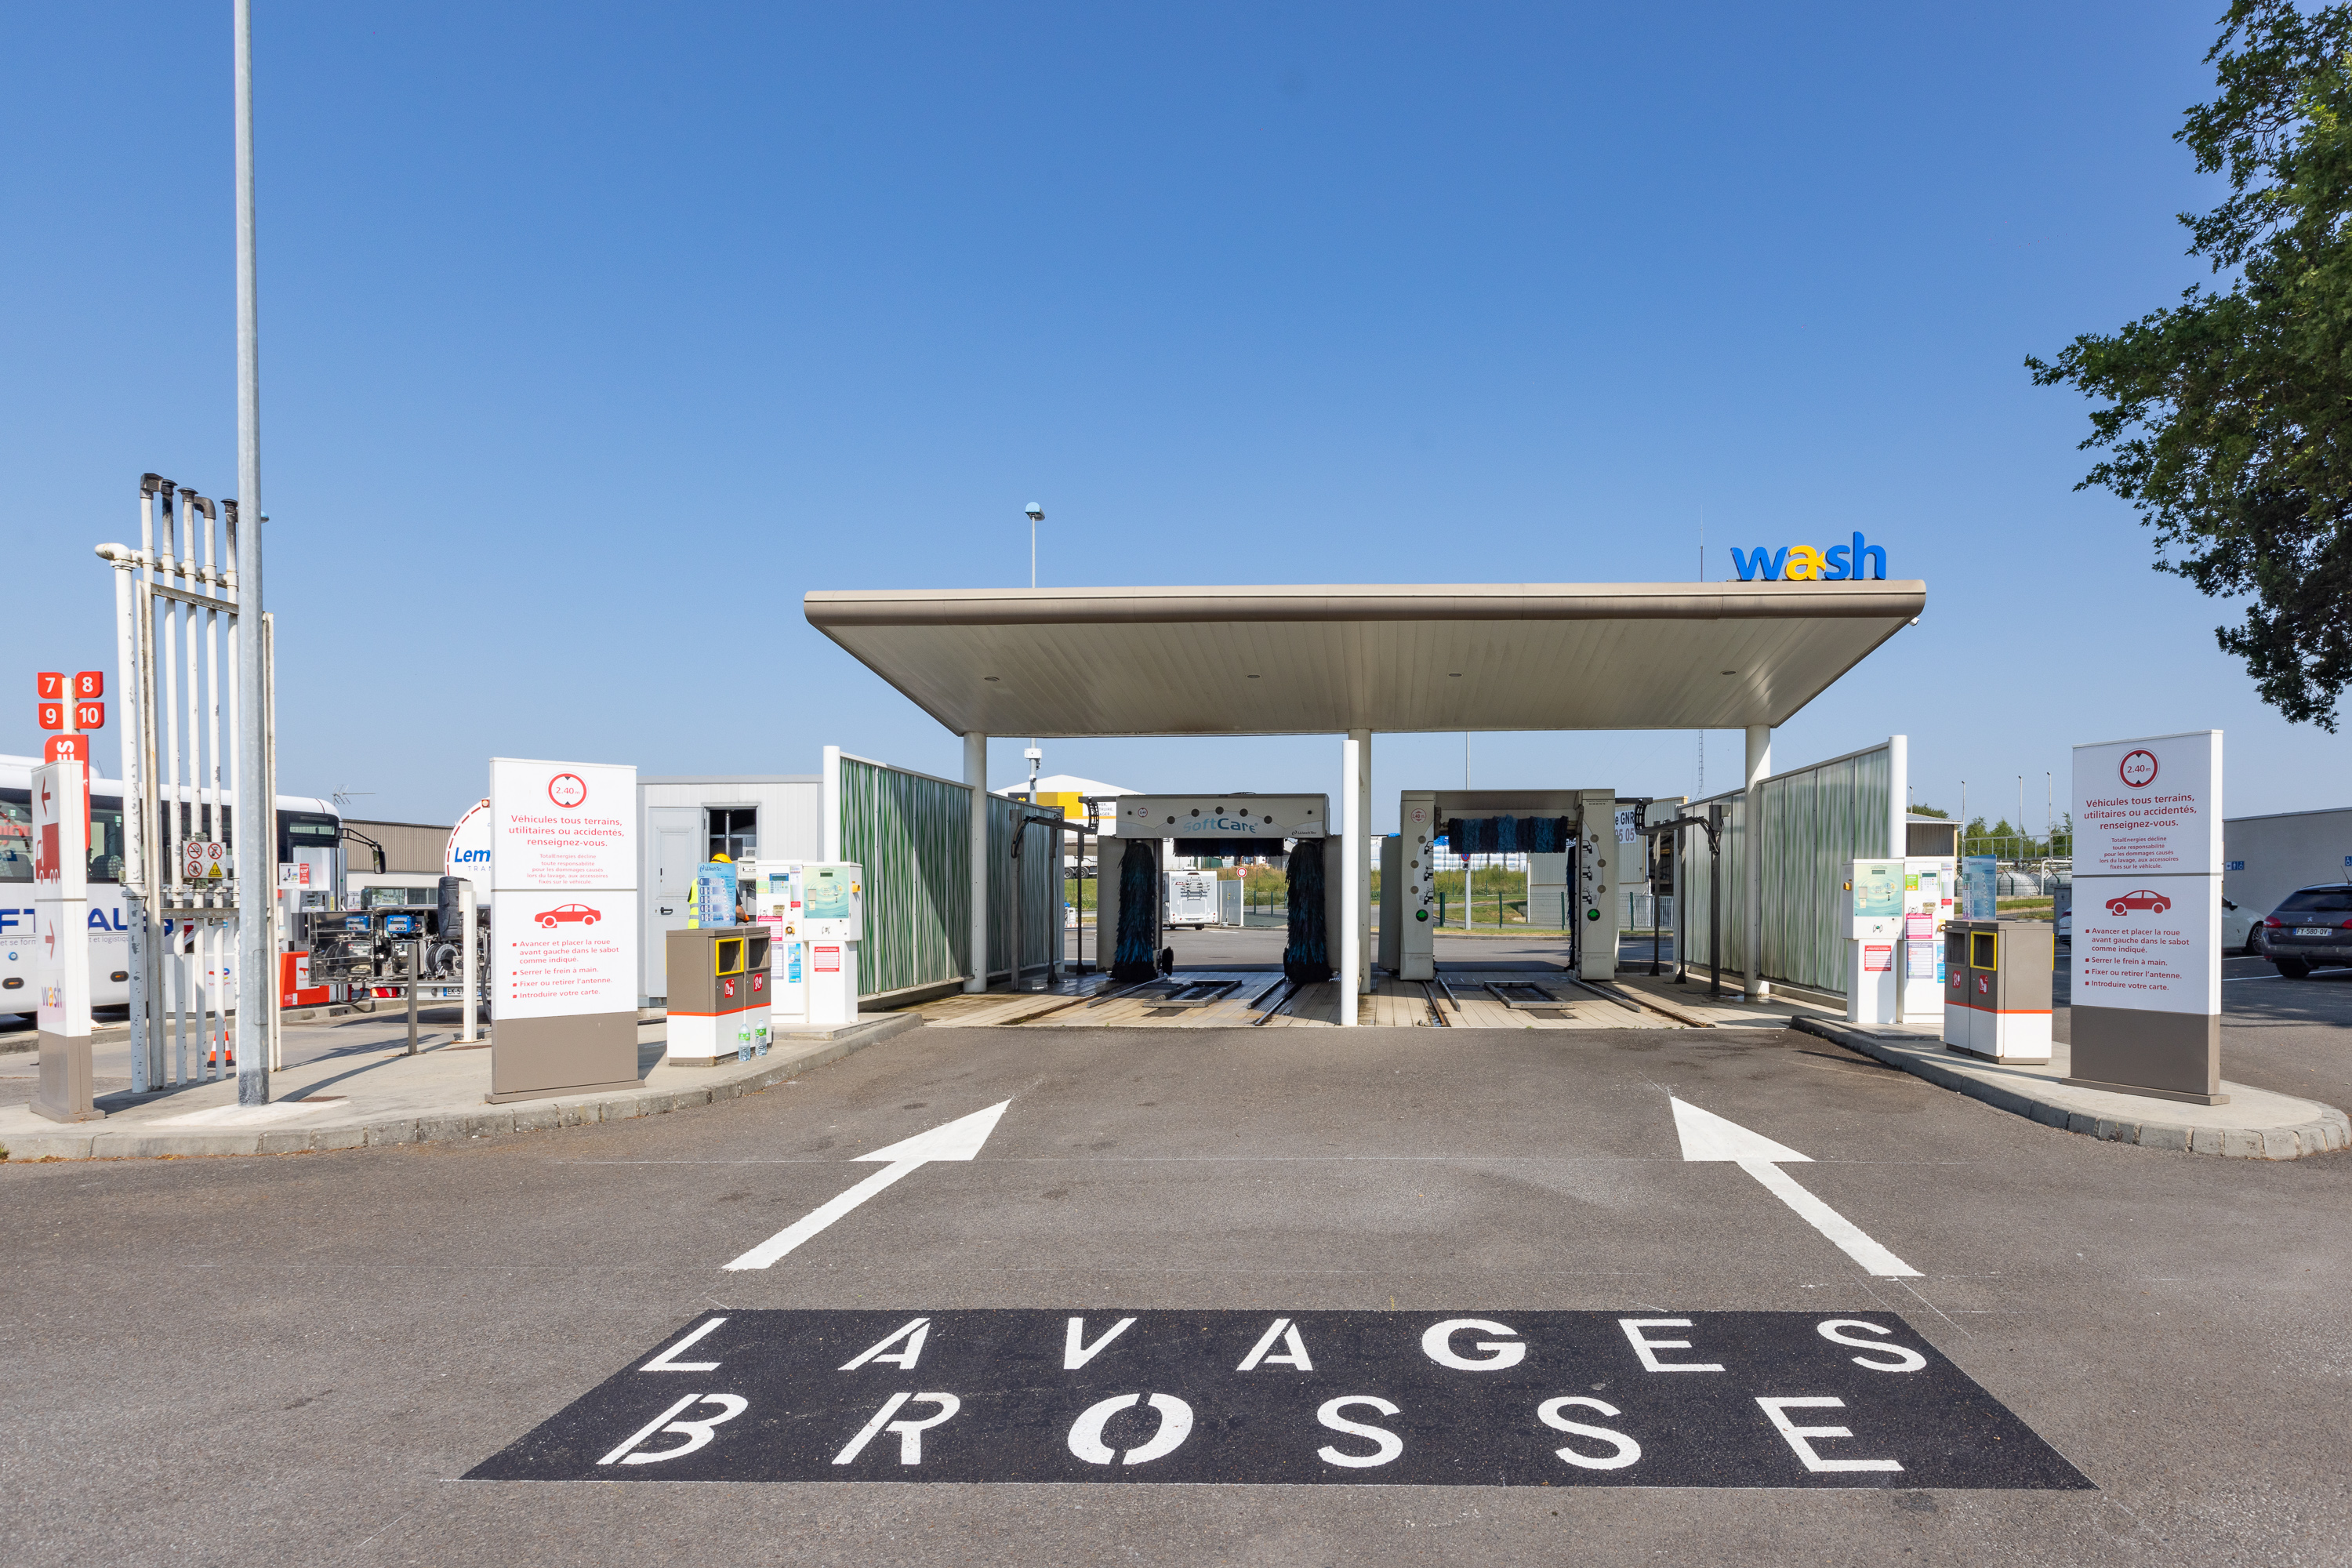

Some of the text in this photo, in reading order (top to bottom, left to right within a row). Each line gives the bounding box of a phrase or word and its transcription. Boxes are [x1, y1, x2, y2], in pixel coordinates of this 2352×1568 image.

[1730, 531, 1886, 580] wash
[45, 677, 56, 693] 7
[82, 677, 93, 692] 8
[45, 708, 56, 724] 9
[79, 708, 98, 723] 10
[2086, 798, 2128, 808] Véhicules
[2154, 793, 2194, 803] terrains,
[1621, 811, 1635, 825] GNR
[2084, 810, 2126, 819] utilitaires
[2143, 805, 2197, 815] accidentés,
[511, 815, 557, 824] Véhicules
[585, 818, 622, 826] terrains,
[2100, 819, 2179, 830] renseignez-vous.
[509, 826, 555, 835] utilitaires
[574, 828, 625, 837] accidentés,
[1625, 827, 1634, 841] 05
[527, 838, 608, 848] renseignez-vous.
[455, 847, 491, 862] Lem
[102, 935, 129, 944] logistiqu
[2145, 971, 2182, 979] l’antenne.
[42, 979, 63, 1008] wash
[638, 1317, 1928, 1372] LAVAGES
[596, 1393, 1905, 1471] BROSSE
